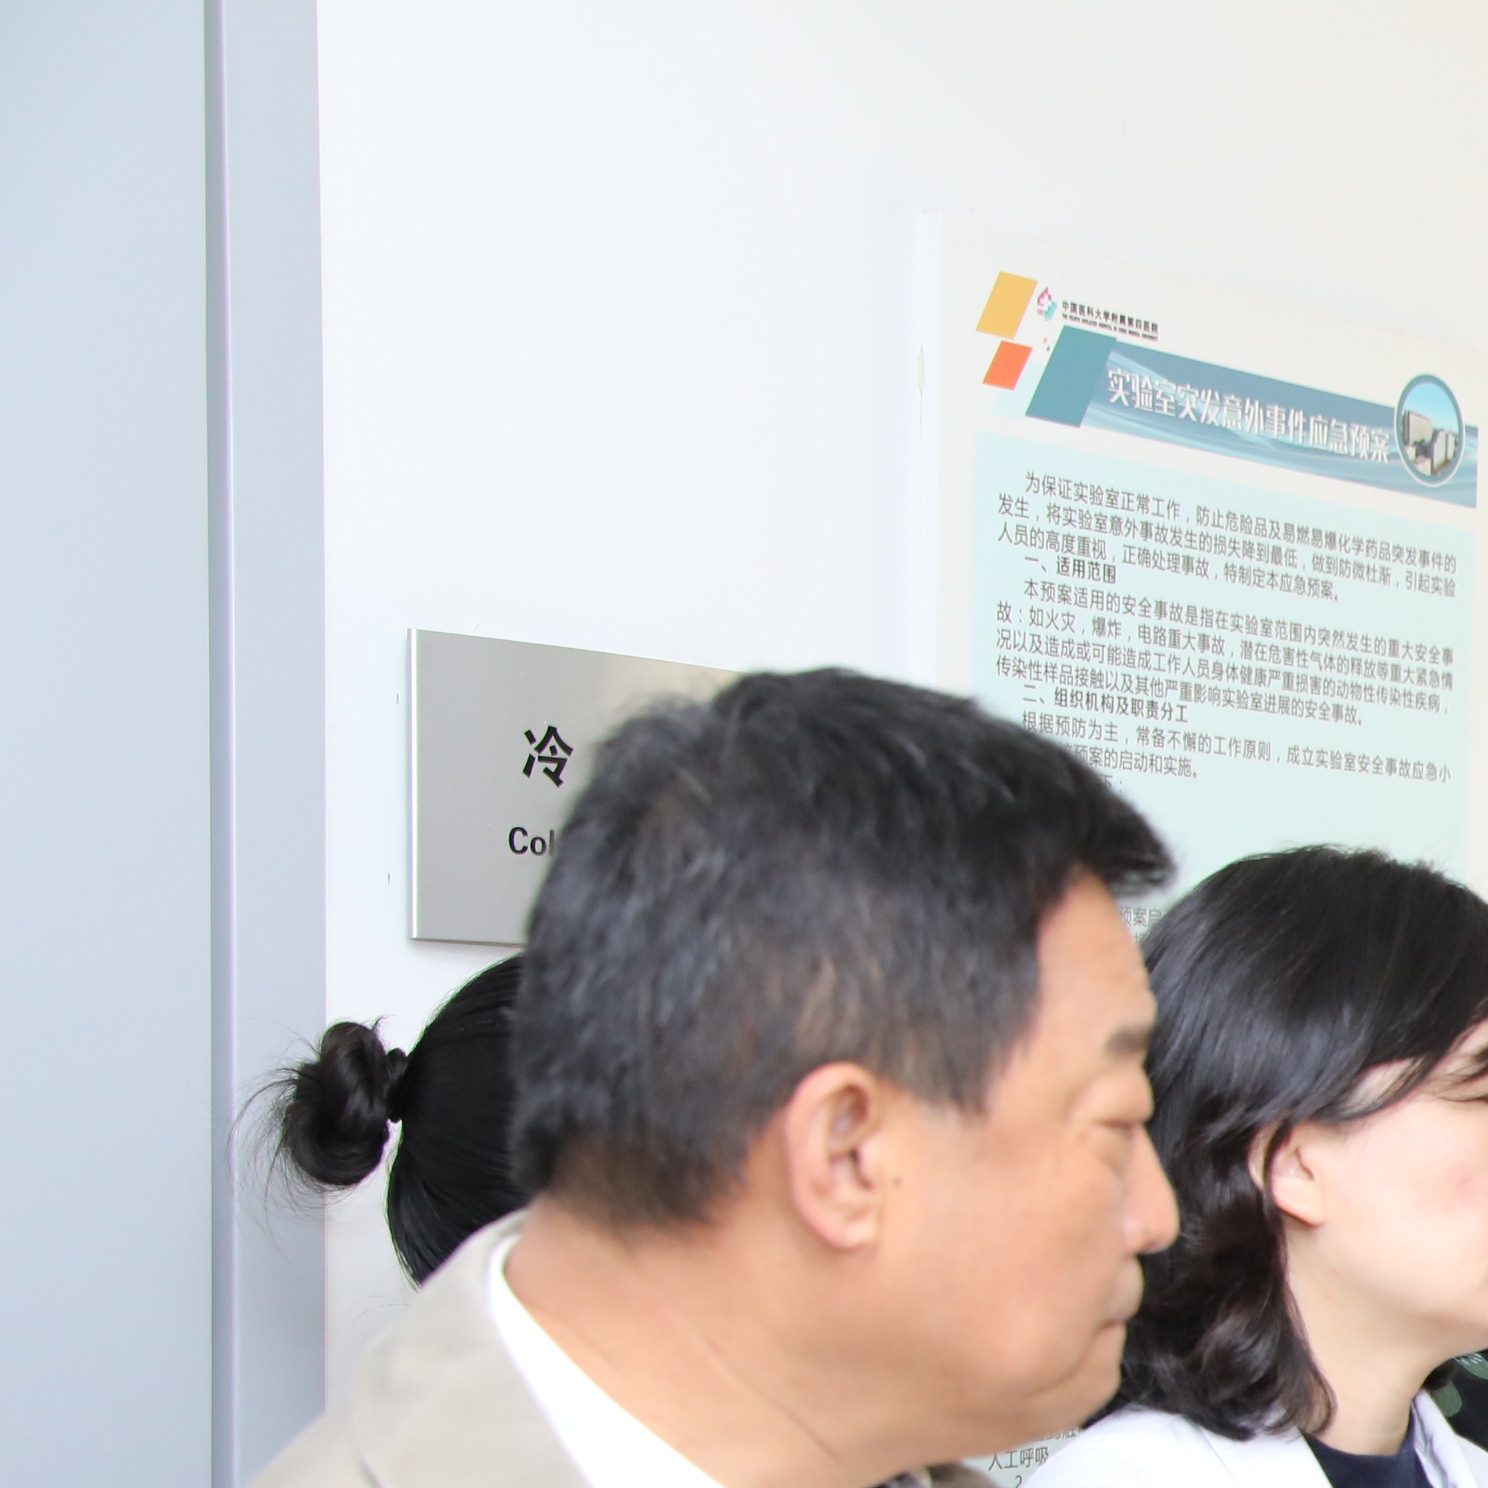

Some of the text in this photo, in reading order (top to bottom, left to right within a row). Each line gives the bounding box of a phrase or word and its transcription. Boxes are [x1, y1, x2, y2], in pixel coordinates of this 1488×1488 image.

[1107, 367, 1390, 464] 实验室突发意外事件应急预案
[1024, 554, 1116, 585] 一、适用范围
[1022, 684, 1189, 723] 二、组织机构及职责分工
[521, 725, 574, 788] 冷
